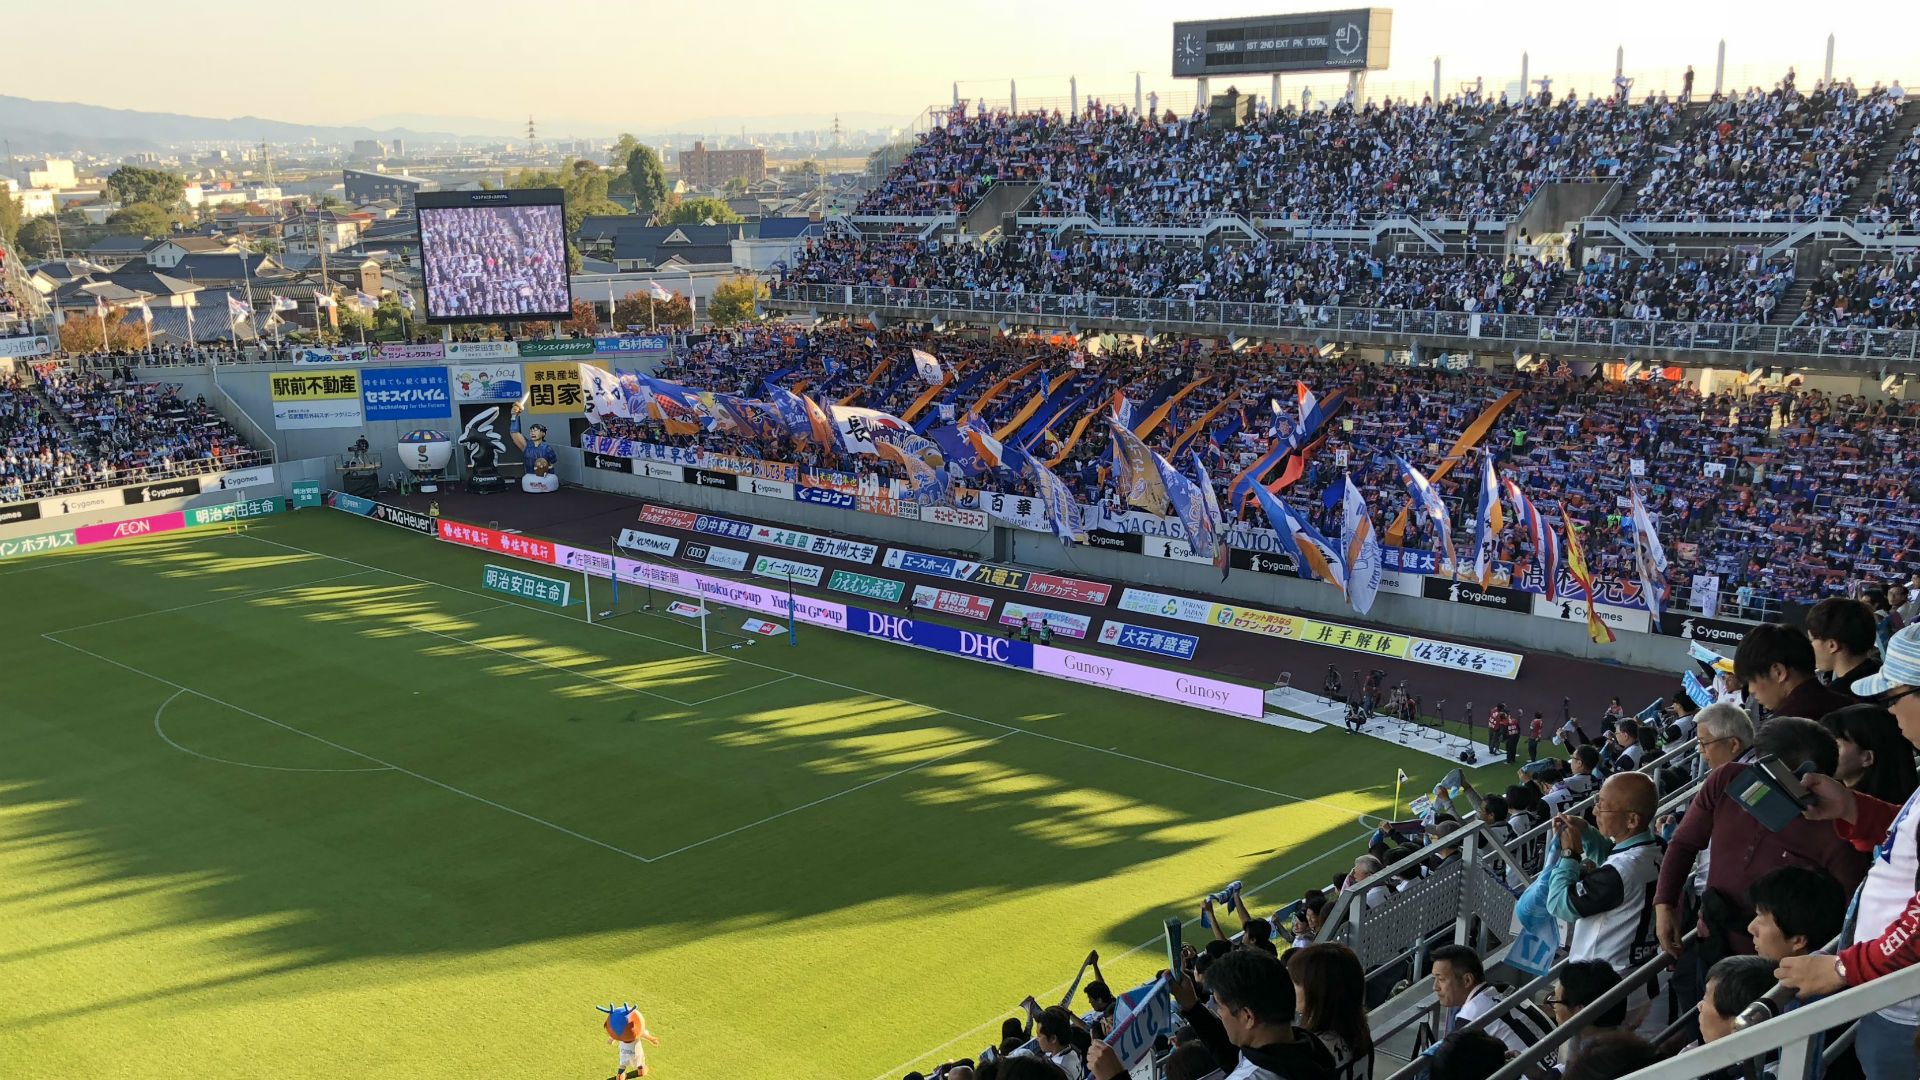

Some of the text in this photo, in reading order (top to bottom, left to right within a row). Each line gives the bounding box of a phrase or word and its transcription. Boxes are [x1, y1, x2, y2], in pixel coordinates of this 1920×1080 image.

[1216, 37, 1328, 52] TEAM 1ST 2ND EXT PK TOTAL
[272, 374, 357, 396] 駅前不動産
[378, 403, 409, 411] Technology
[600, 458, 622, 469] Cygames
[650, 465, 673, 477] Cygames
[227, 475, 259, 487] Cygames
[702, 475, 726, 486] Cygames
[757, 483, 782, 495] Cygames
[151, 485, 185, 499] Cygames
[810, 488, 853, 507] ニシケン
[195, 501, 274, 525] 明治安田生命
[453, 525, 489, 547] 佐賀銀行
[707, 519, 750, 539] 中野建設
[511, 536, 549, 560] 佐賀銀行
[636, 535, 671, 552] KUSANAGI
[812, 536, 874, 563] 西九州大学
[1091, 534, 1125, 547] Cygames
[574, 553, 610, 571] 佐賀新聞
[768, 561, 818, 580] イーグルハウス
[903, 554, 950, 574] エースホーム
[486, 569, 560, 602] 明治安田生命
[832, 572, 898, 601] うえむら病院
[975, 564, 1024, 590] 九電工
[695, 578, 762, 606] Yutoku Group
[1029, 579, 1105, 604] 九州アカデミー学園
[1460, 588, 1508, 606] Cygames
[807, 605, 843, 624] Group
[1181, 599, 1206, 611] SPRING
[1183, 607, 1204, 618] JAPAN
[868, 611, 913, 643] DHC
[1696, 624, 1744, 642] Cygame
[959, 630, 1010, 662] DHC
[1121, 628, 1193, 656] 大石膏盛堂
[1316, 625, 1393, 653] 井手解体
[1414, 641, 1487, 671] 佐賀海苔
[1064, 655, 1114, 679] Gunosy
[1175, 677, 1231, 705] Gunosy
